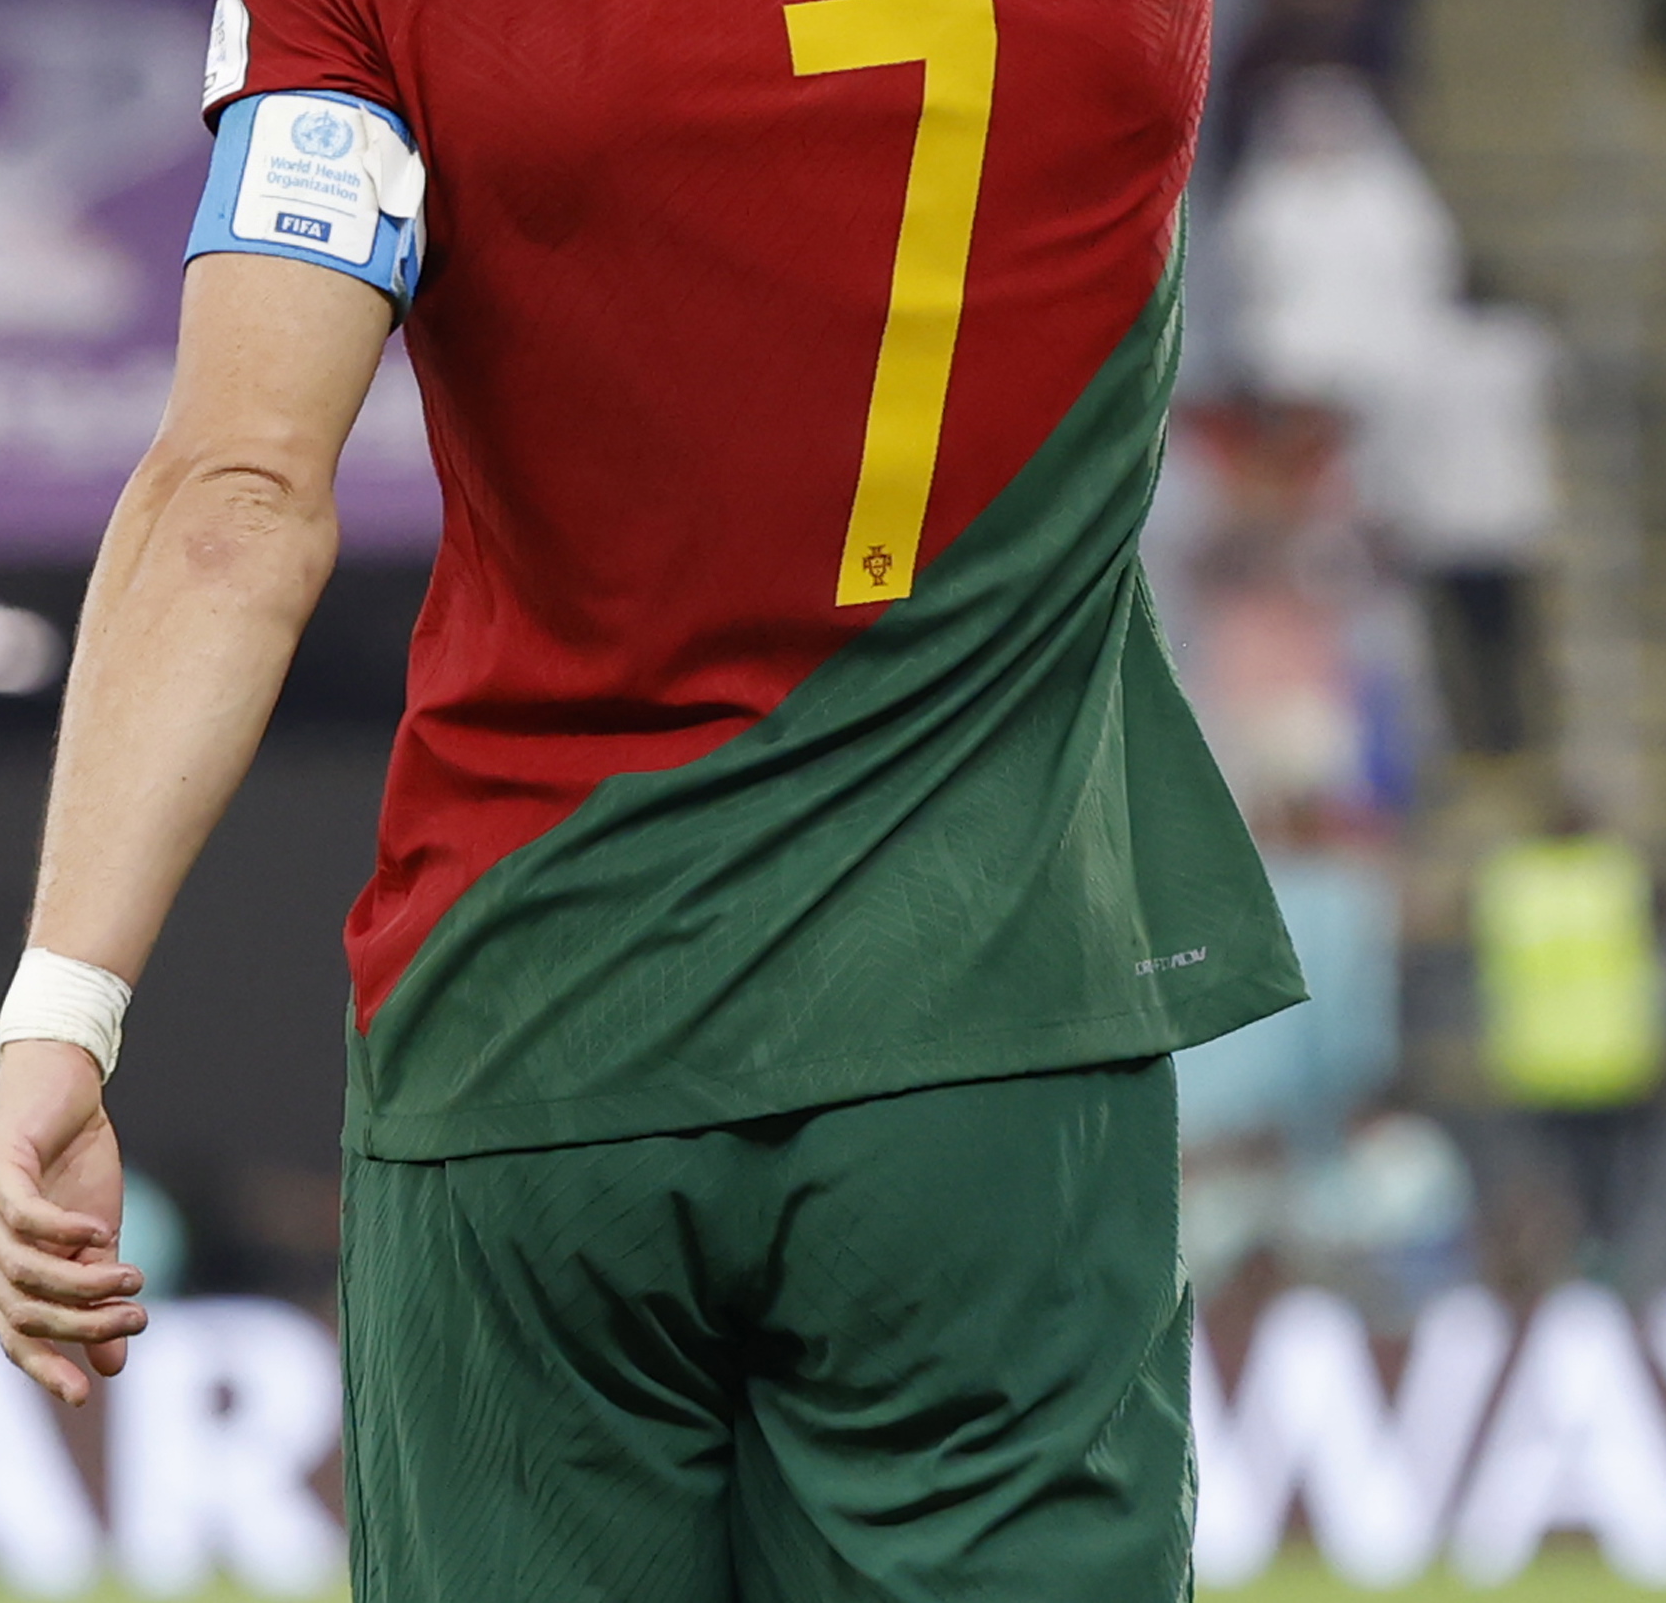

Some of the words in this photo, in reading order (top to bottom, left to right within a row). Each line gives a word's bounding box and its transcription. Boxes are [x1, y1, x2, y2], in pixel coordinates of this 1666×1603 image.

[266, 171, 358, 202] Organization
[270, 155, 311, 175] World
[316, 163, 361, 188] Health
[282, 215, 323, 238] FIFA
